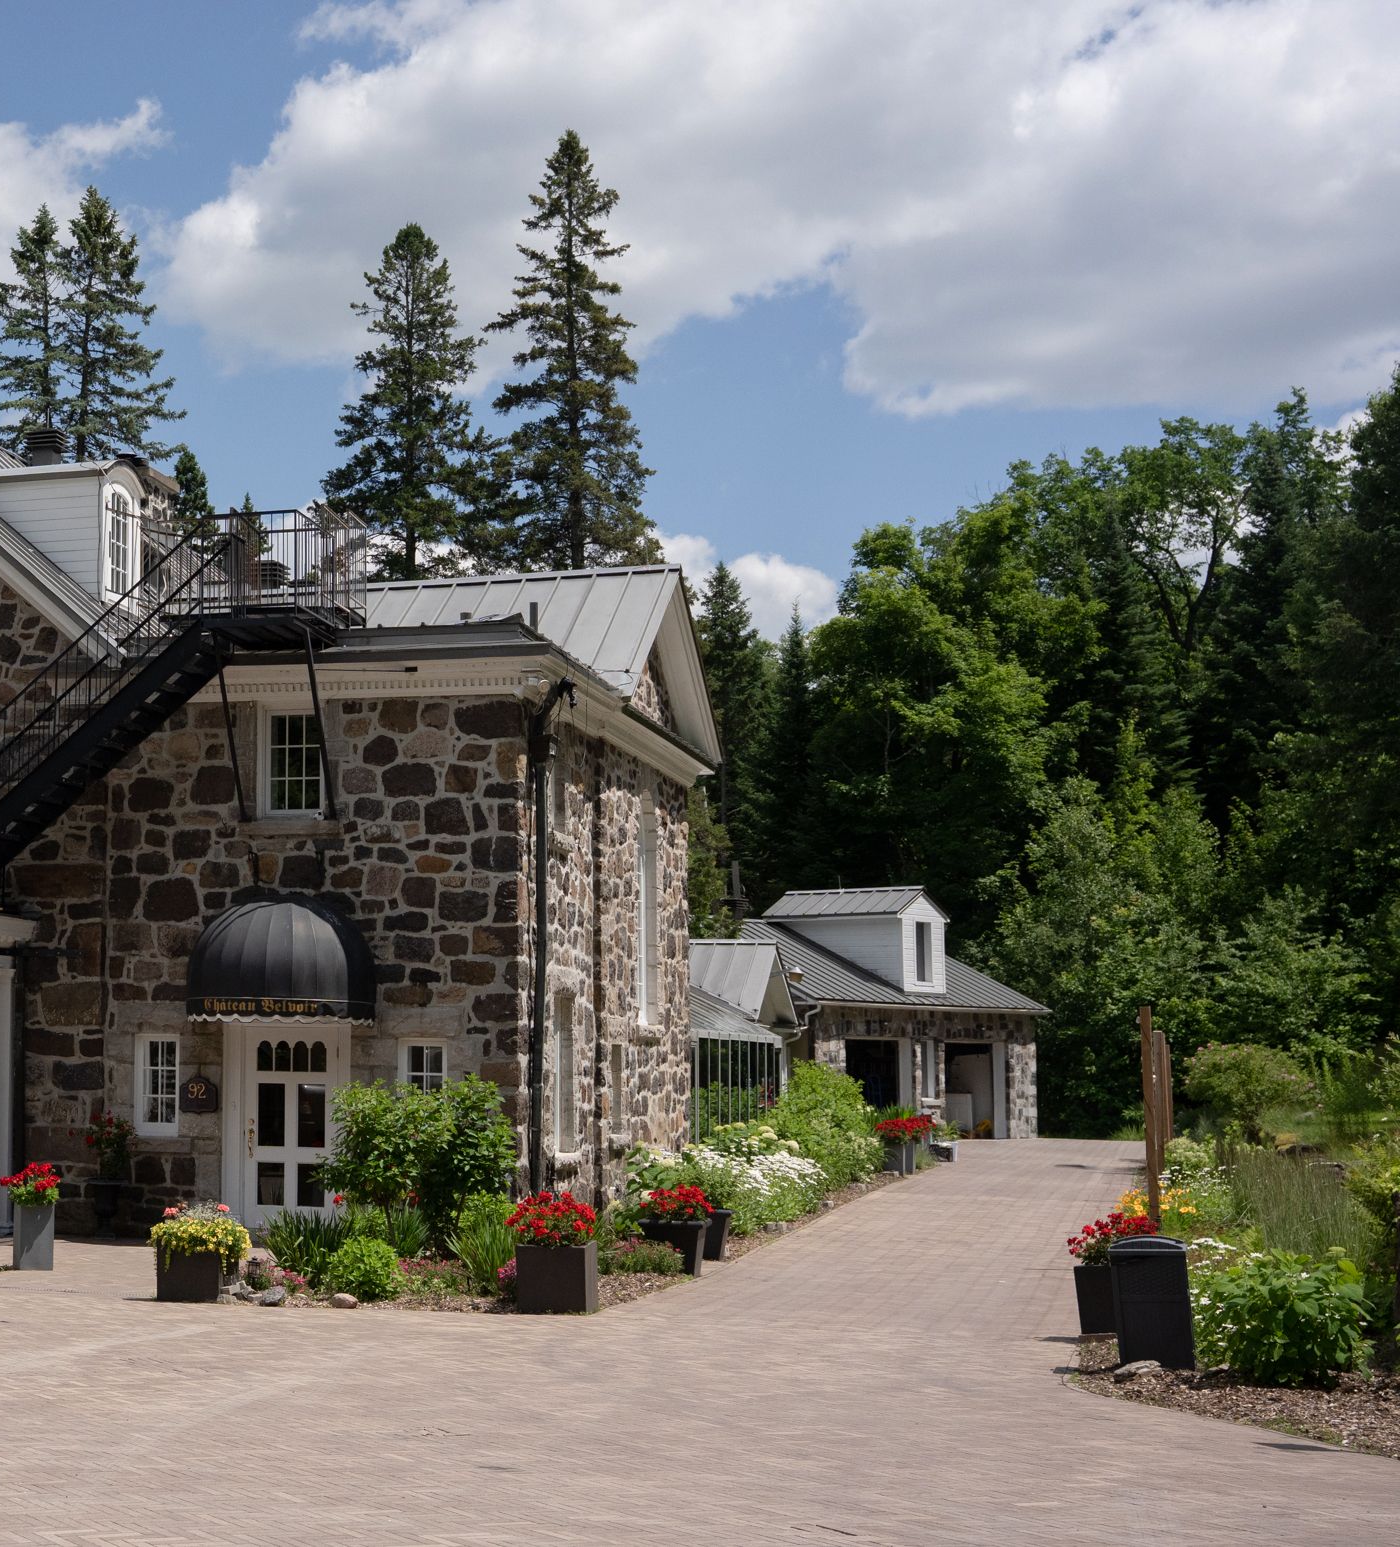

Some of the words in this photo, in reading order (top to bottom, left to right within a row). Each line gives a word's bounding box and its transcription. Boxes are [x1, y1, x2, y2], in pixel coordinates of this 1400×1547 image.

[203, 998, 256, 1013] Château
[261, 998, 318, 1013] Belvoir
[187, 1083, 206, 1099] 92
